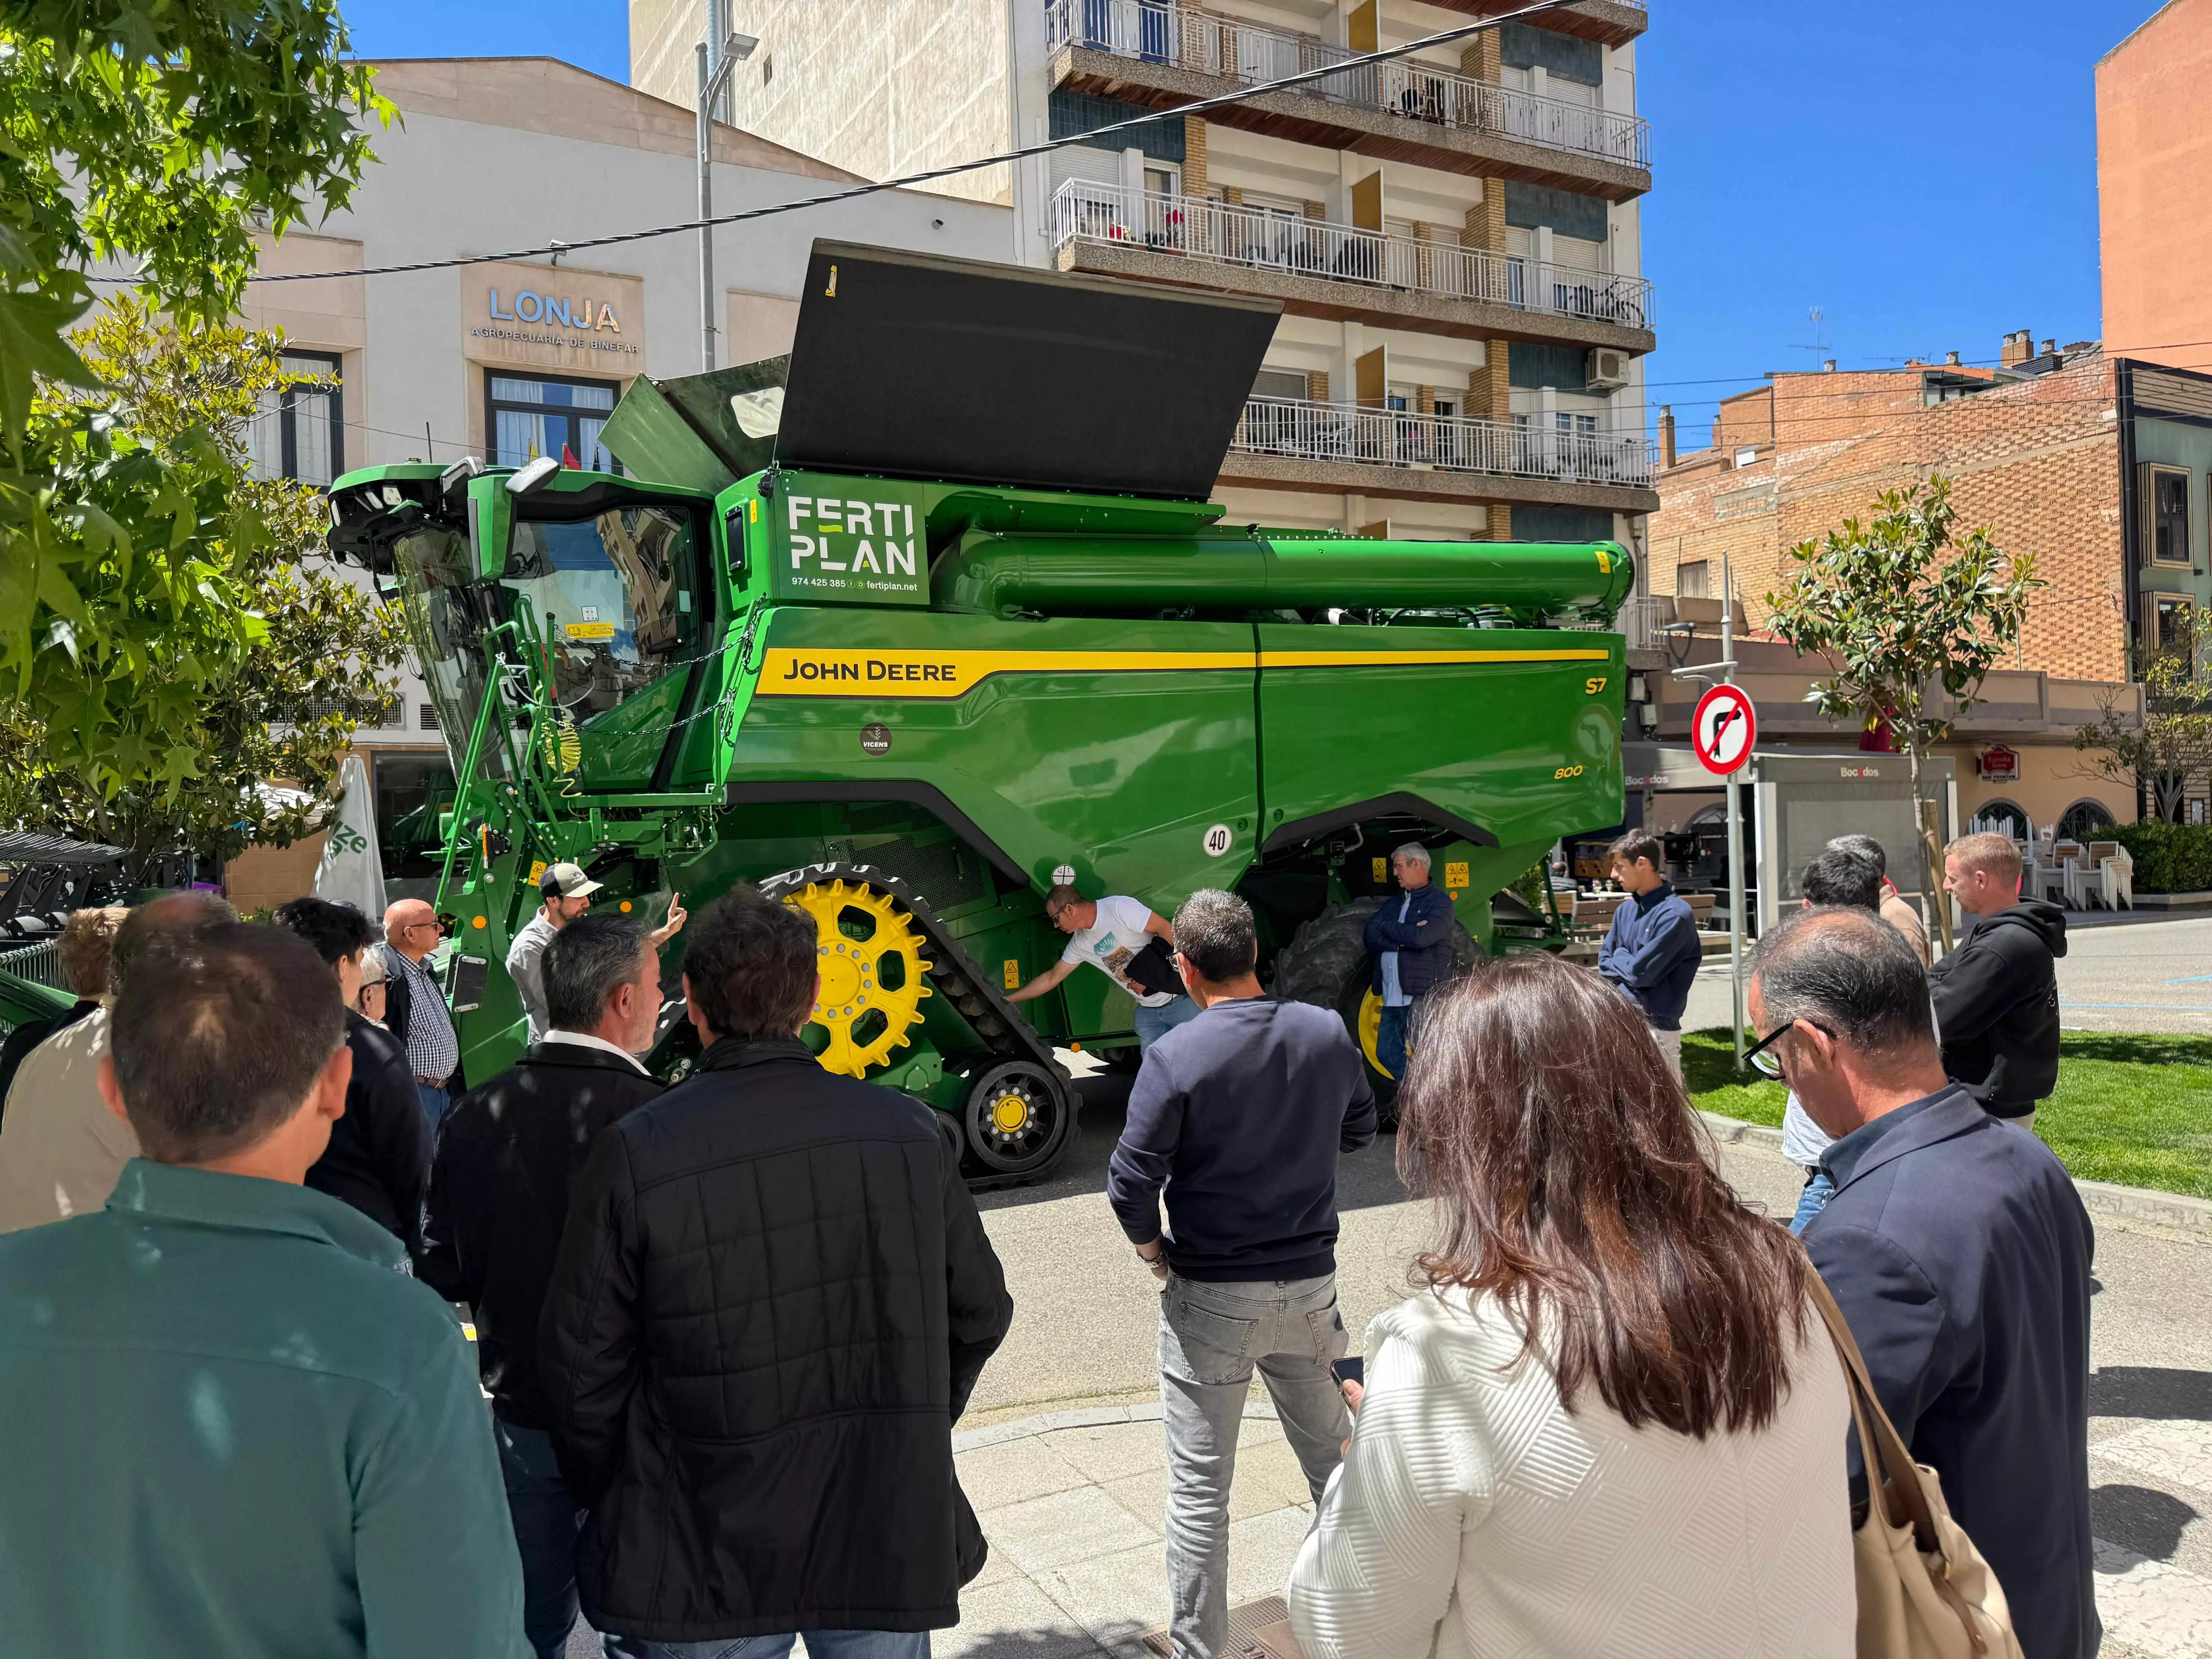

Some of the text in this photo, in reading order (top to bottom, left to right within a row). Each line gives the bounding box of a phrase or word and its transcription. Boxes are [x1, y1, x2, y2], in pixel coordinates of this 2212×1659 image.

[490, 289, 620, 334] LONJA
[471, 327, 639, 354] AGROPECUARIA DE BINEFAR
[788, 496, 914, 537] FERTI
[790, 534, 916, 575] PLAN
[791, 577, 918, 591] 974 425 385 fertiplan.net
[783, 658, 957, 682] JOHN DEERE
[1585, 677, 1607, 695] S7
[1554, 765, 1583, 779] 800
[1209, 830, 1225, 851] 40
